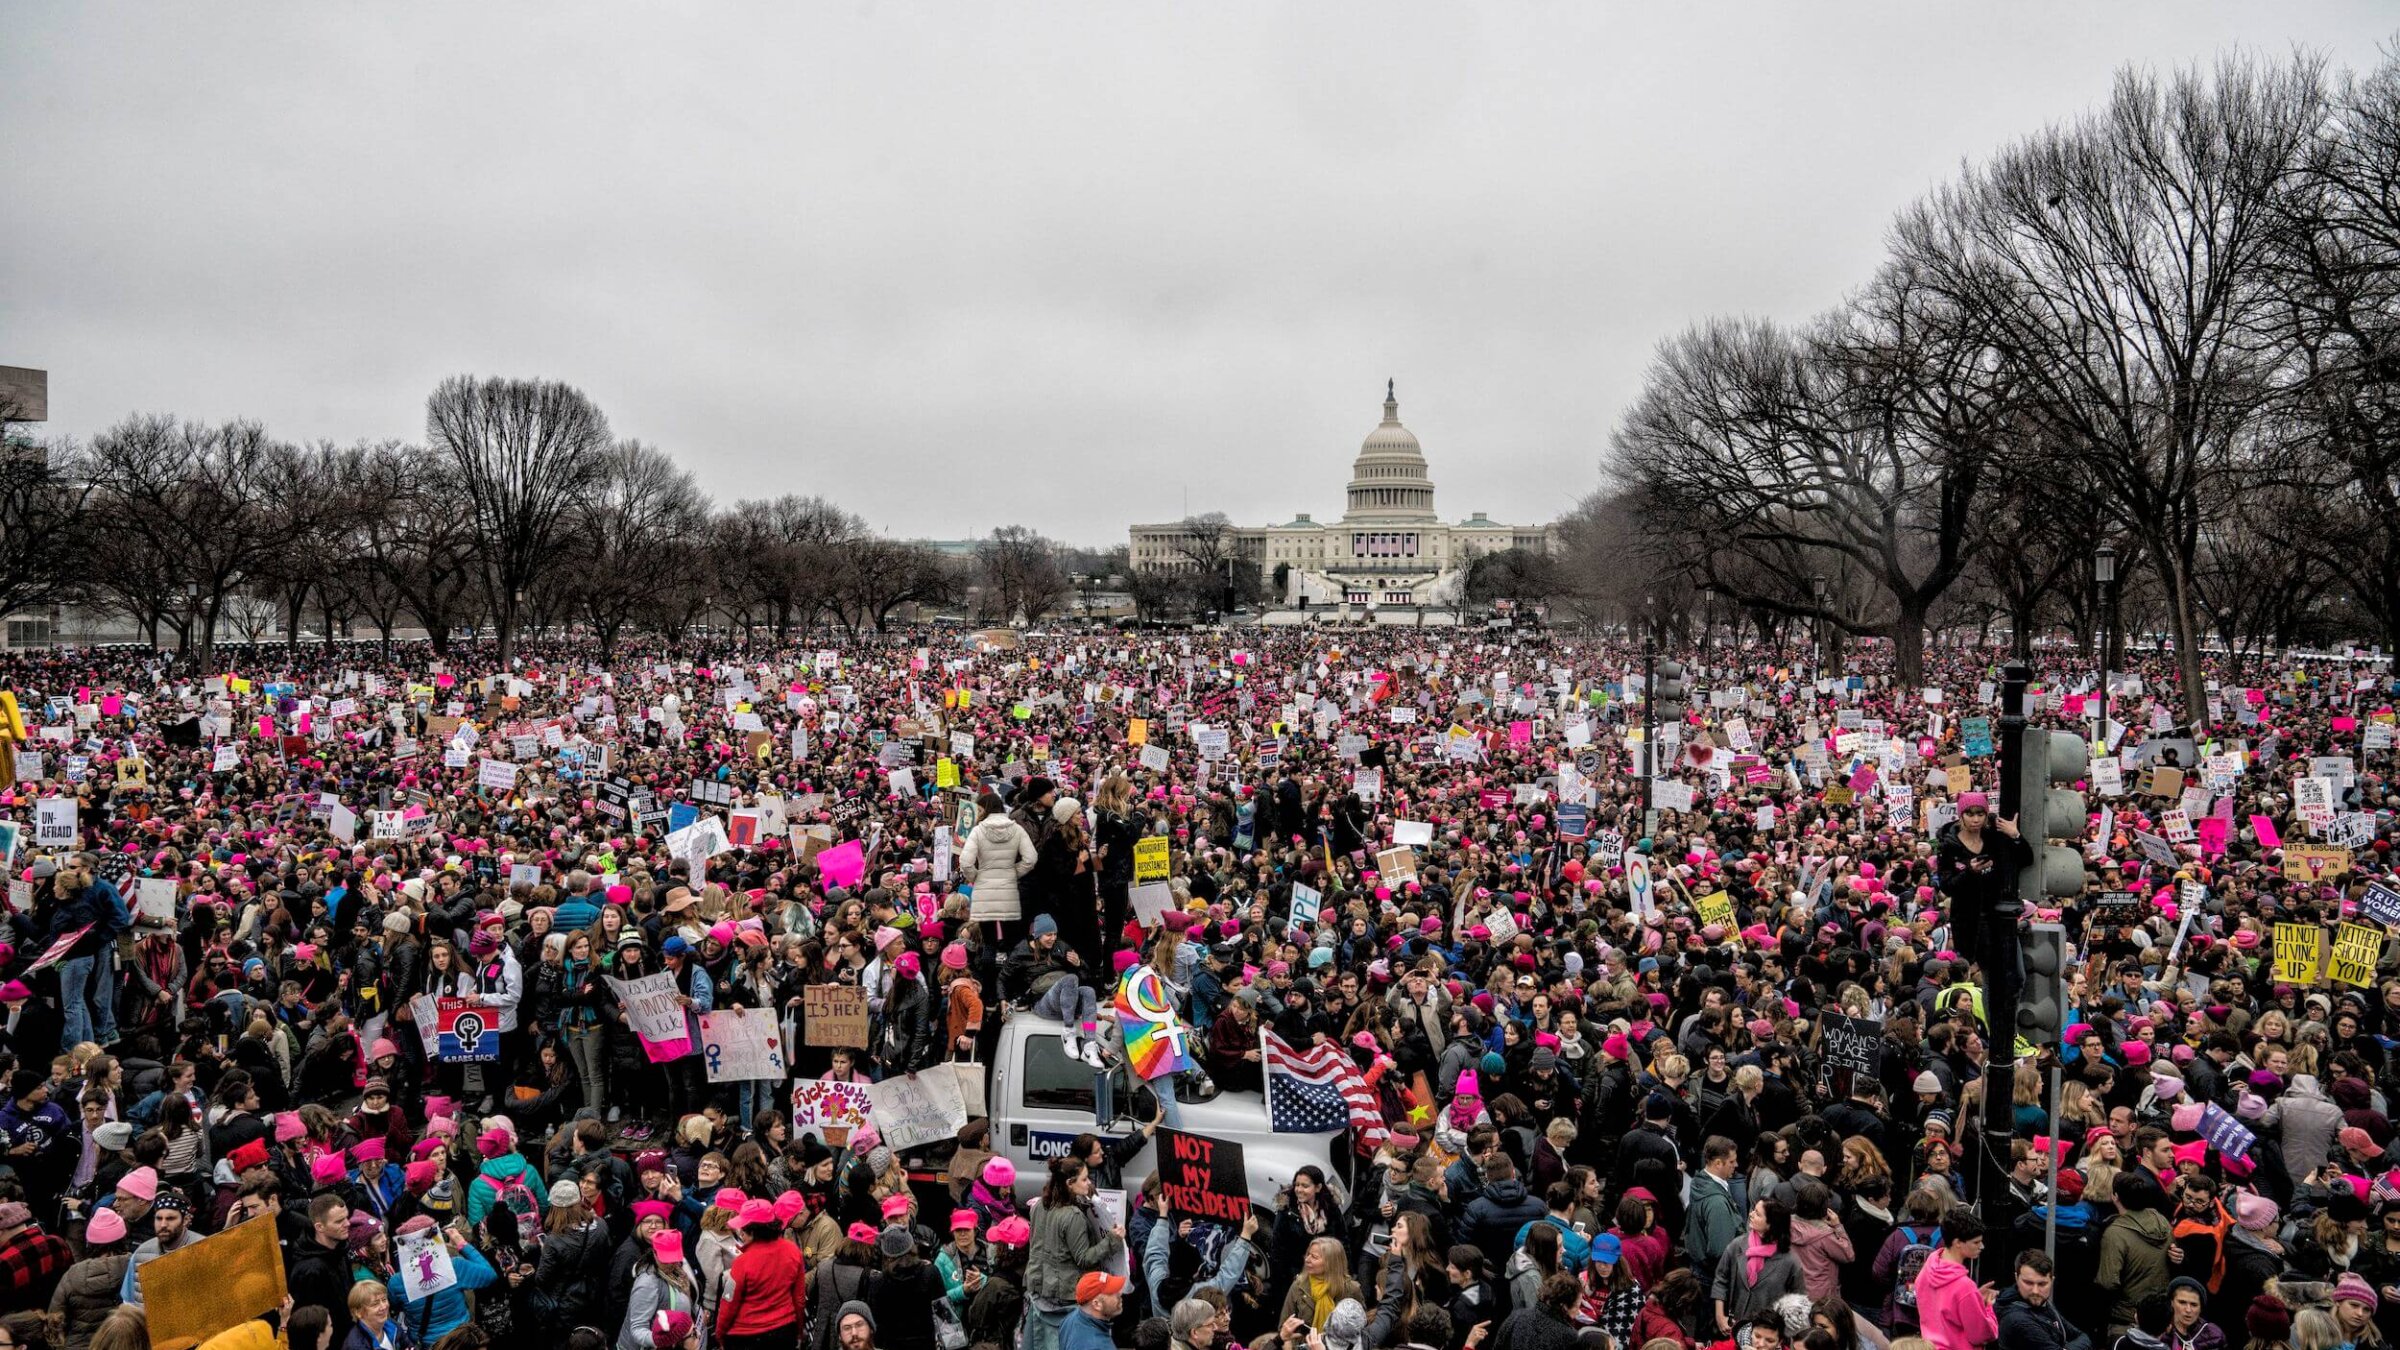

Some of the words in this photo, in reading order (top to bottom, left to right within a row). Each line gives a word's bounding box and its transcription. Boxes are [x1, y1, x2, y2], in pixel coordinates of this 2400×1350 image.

[1261, 754, 1277, 764] BIG
[832, 796, 861, 814] NASTY
[1890, 796, 1911, 804] WANT
[42, 812, 57, 824] UN-
[378, 813, 382, 822] I
[836, 804, 867, 822] WOMEN
[1890, 804, 1912, 822] THIS
[2163, 812, 2184, 821] OMG
[2310, 813, 2334, 822] DUMP
[41, 826, 72, 838] AFRAID
[376, 828, 401, 836] PRESS
[1604, 834, 1622, 844] SAY
[2170, 830, 2188, 838] WTF
[1137, 844, 1166, 854] INAUGURATE
[1603, 845, 1620, 854] HER
[2312, 844, 2345, 852] DISCUSS
[1138, 860, 1166, 872] RESISTANCE
[1604, 857, 1618, 868] AME
[1697, 901, 1704, 911] I
[1701, 904, 1730, 922] STAND
[2276, 926, 2293, 942] I'M
[2296, 928, 2318, 944] NOT
[2338, 924, 2380, 950] NEITHER
[2276, 942, 2315, 962] GIVING
[2334, 942, 2376, 966] SHOULD
[2288, 962, 2306, 979] UP
[2336, 960, 2366, 982] YOU
[807, 988, 854, 1002] THIS
[442, 1000, 462, 1010] THIS
[808, 1004, 829, 1018] IS
[834, 1004, 860, 1016] HER
[1844, 1017, 1855, 1032] A
[1823, 1024, 1878, 1050] WOMAN'S
[1830, 1040, 1868, 1060] PLACE
[444, 1055, 473, 1063] GRABS
[476, 1054, 496, 1062] BACK
[1827, 1055, 1841, 1066] IS
[882, 1081, 922, 1110] Girls
[795, 1106, 814, 1126] MY
[1174, 1134, 1214, 1164] NOT
[1182, 1167, 1210, 1190] MY
[1163, 1183, 1250, 1222] PRESIDENT
